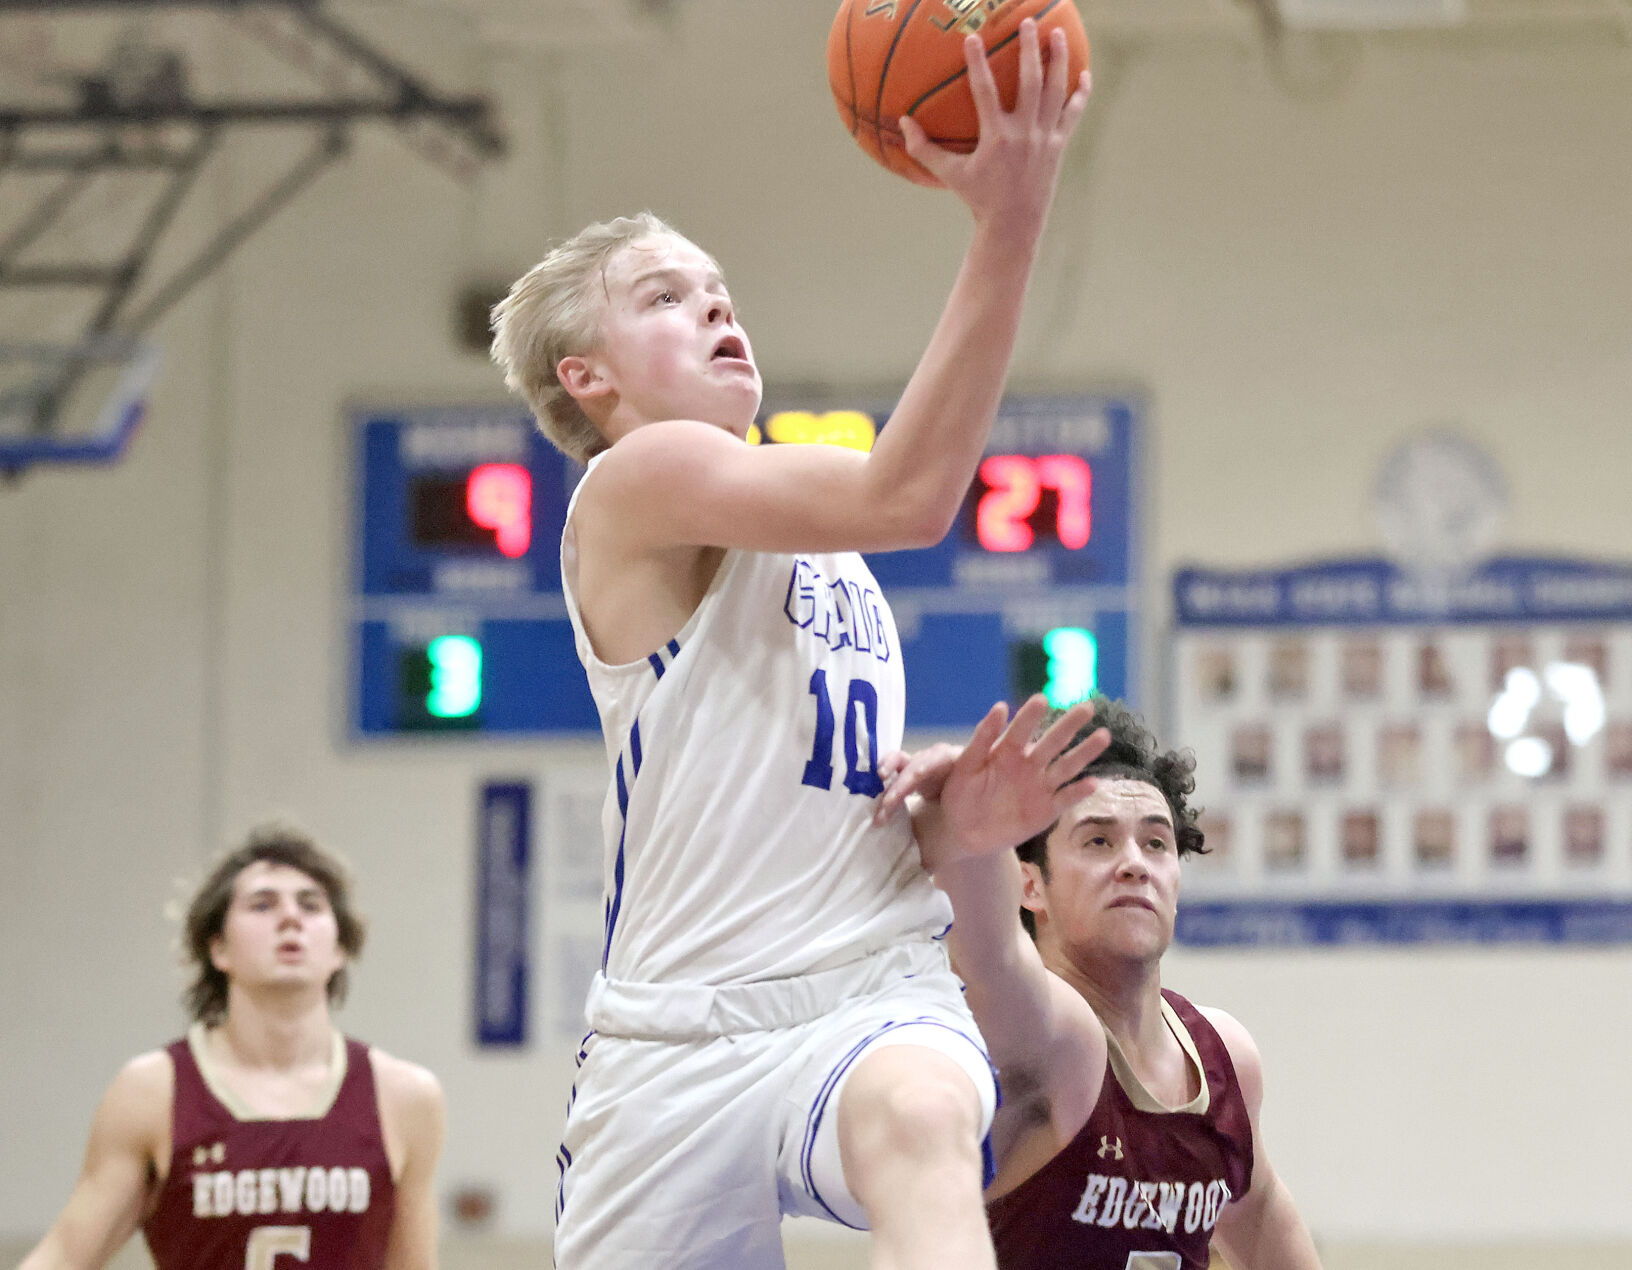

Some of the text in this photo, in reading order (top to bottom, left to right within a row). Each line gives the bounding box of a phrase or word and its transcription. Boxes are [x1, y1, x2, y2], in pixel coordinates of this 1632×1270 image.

[467, 463, 532, 558] 9
[977, 454, 1092, 552] 27
[802, 668, 885, 799] 10
[192, 1166, 371, 1218] EDGEWOOD
